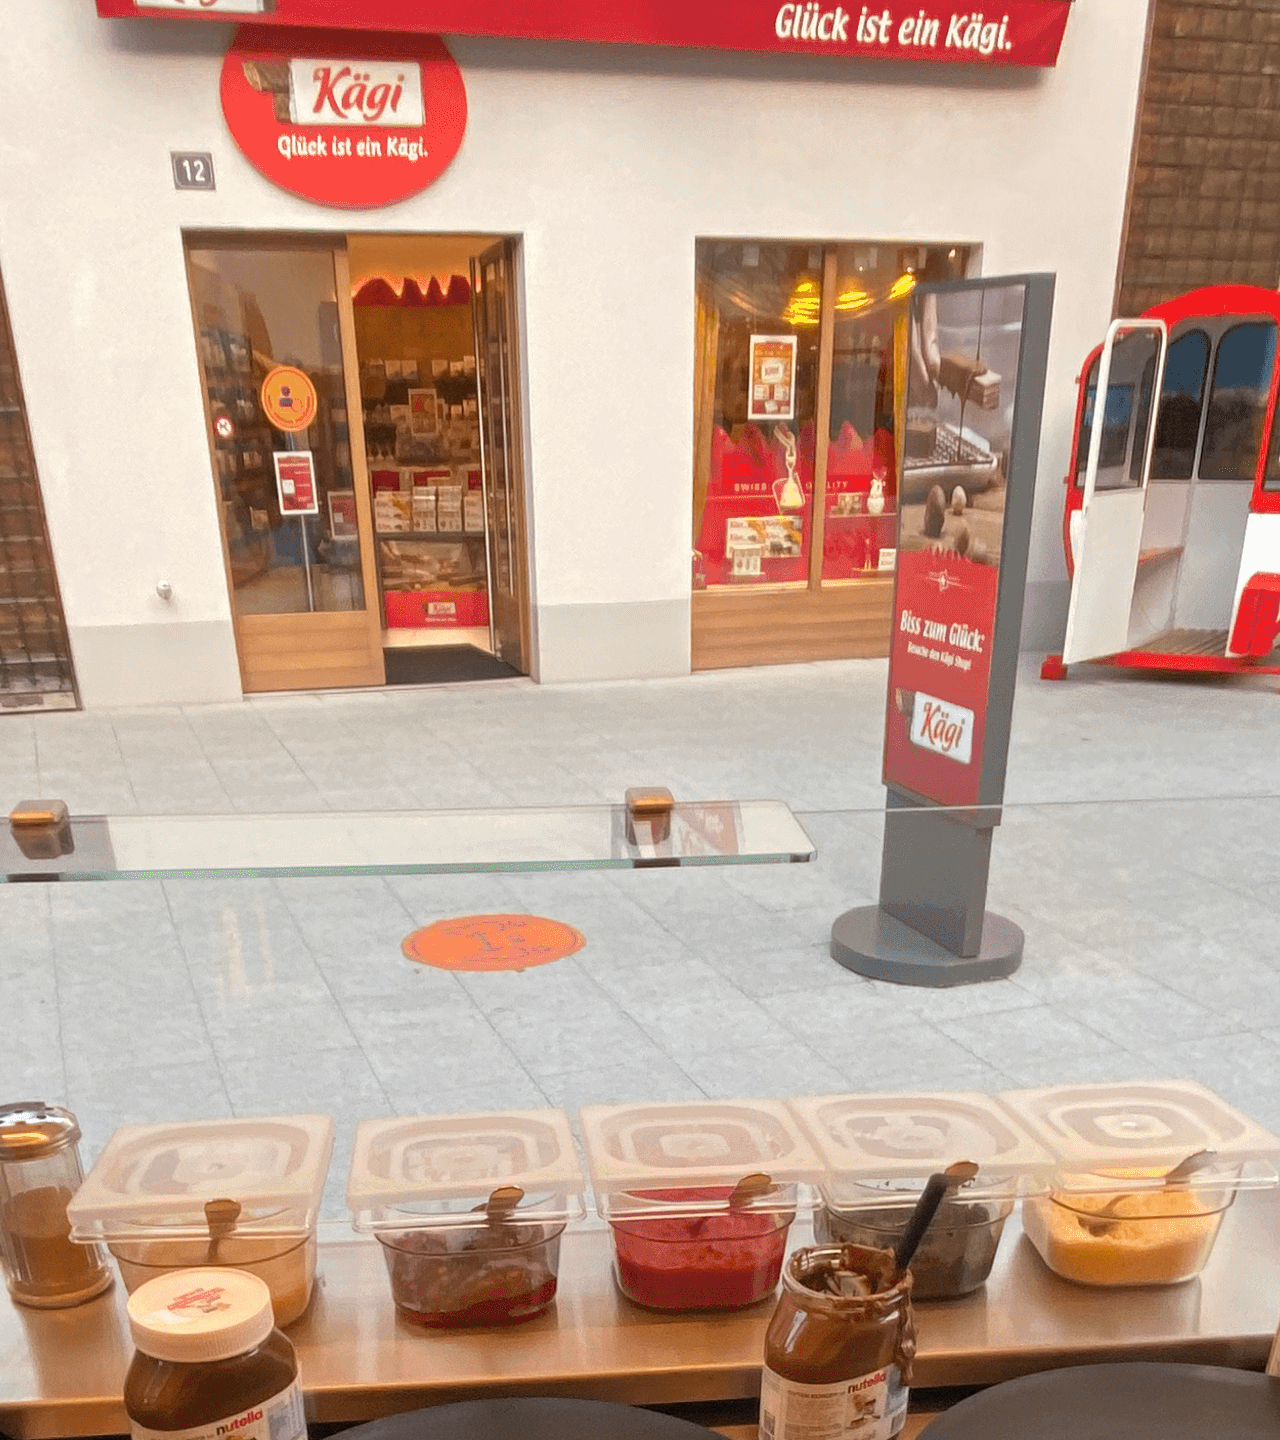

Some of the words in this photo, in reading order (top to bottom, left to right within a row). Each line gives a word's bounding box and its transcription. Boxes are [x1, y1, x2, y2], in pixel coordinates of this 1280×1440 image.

[774, 2, 850, 41] Glück
[856, 6, 892, 44] ist
[898, 9, 940, 48] ein
[945, 13, 1013, 55] Kägi.
[312, 66, 406, 122] Kägi
[332, 136, 352, 157] ist
[356, 135, 382, 158] ein
[386, 136, 429, 161] Kägi.
[182, 159, 206, 182] 12
[900, 609, 922, 636] Biss
[923, 619, 948, 642] zum
[920, 702, 966, 752] Kägi
[848, 1372, 887, 1394] nutella
[216, 1409, 264, 1436] nutella
